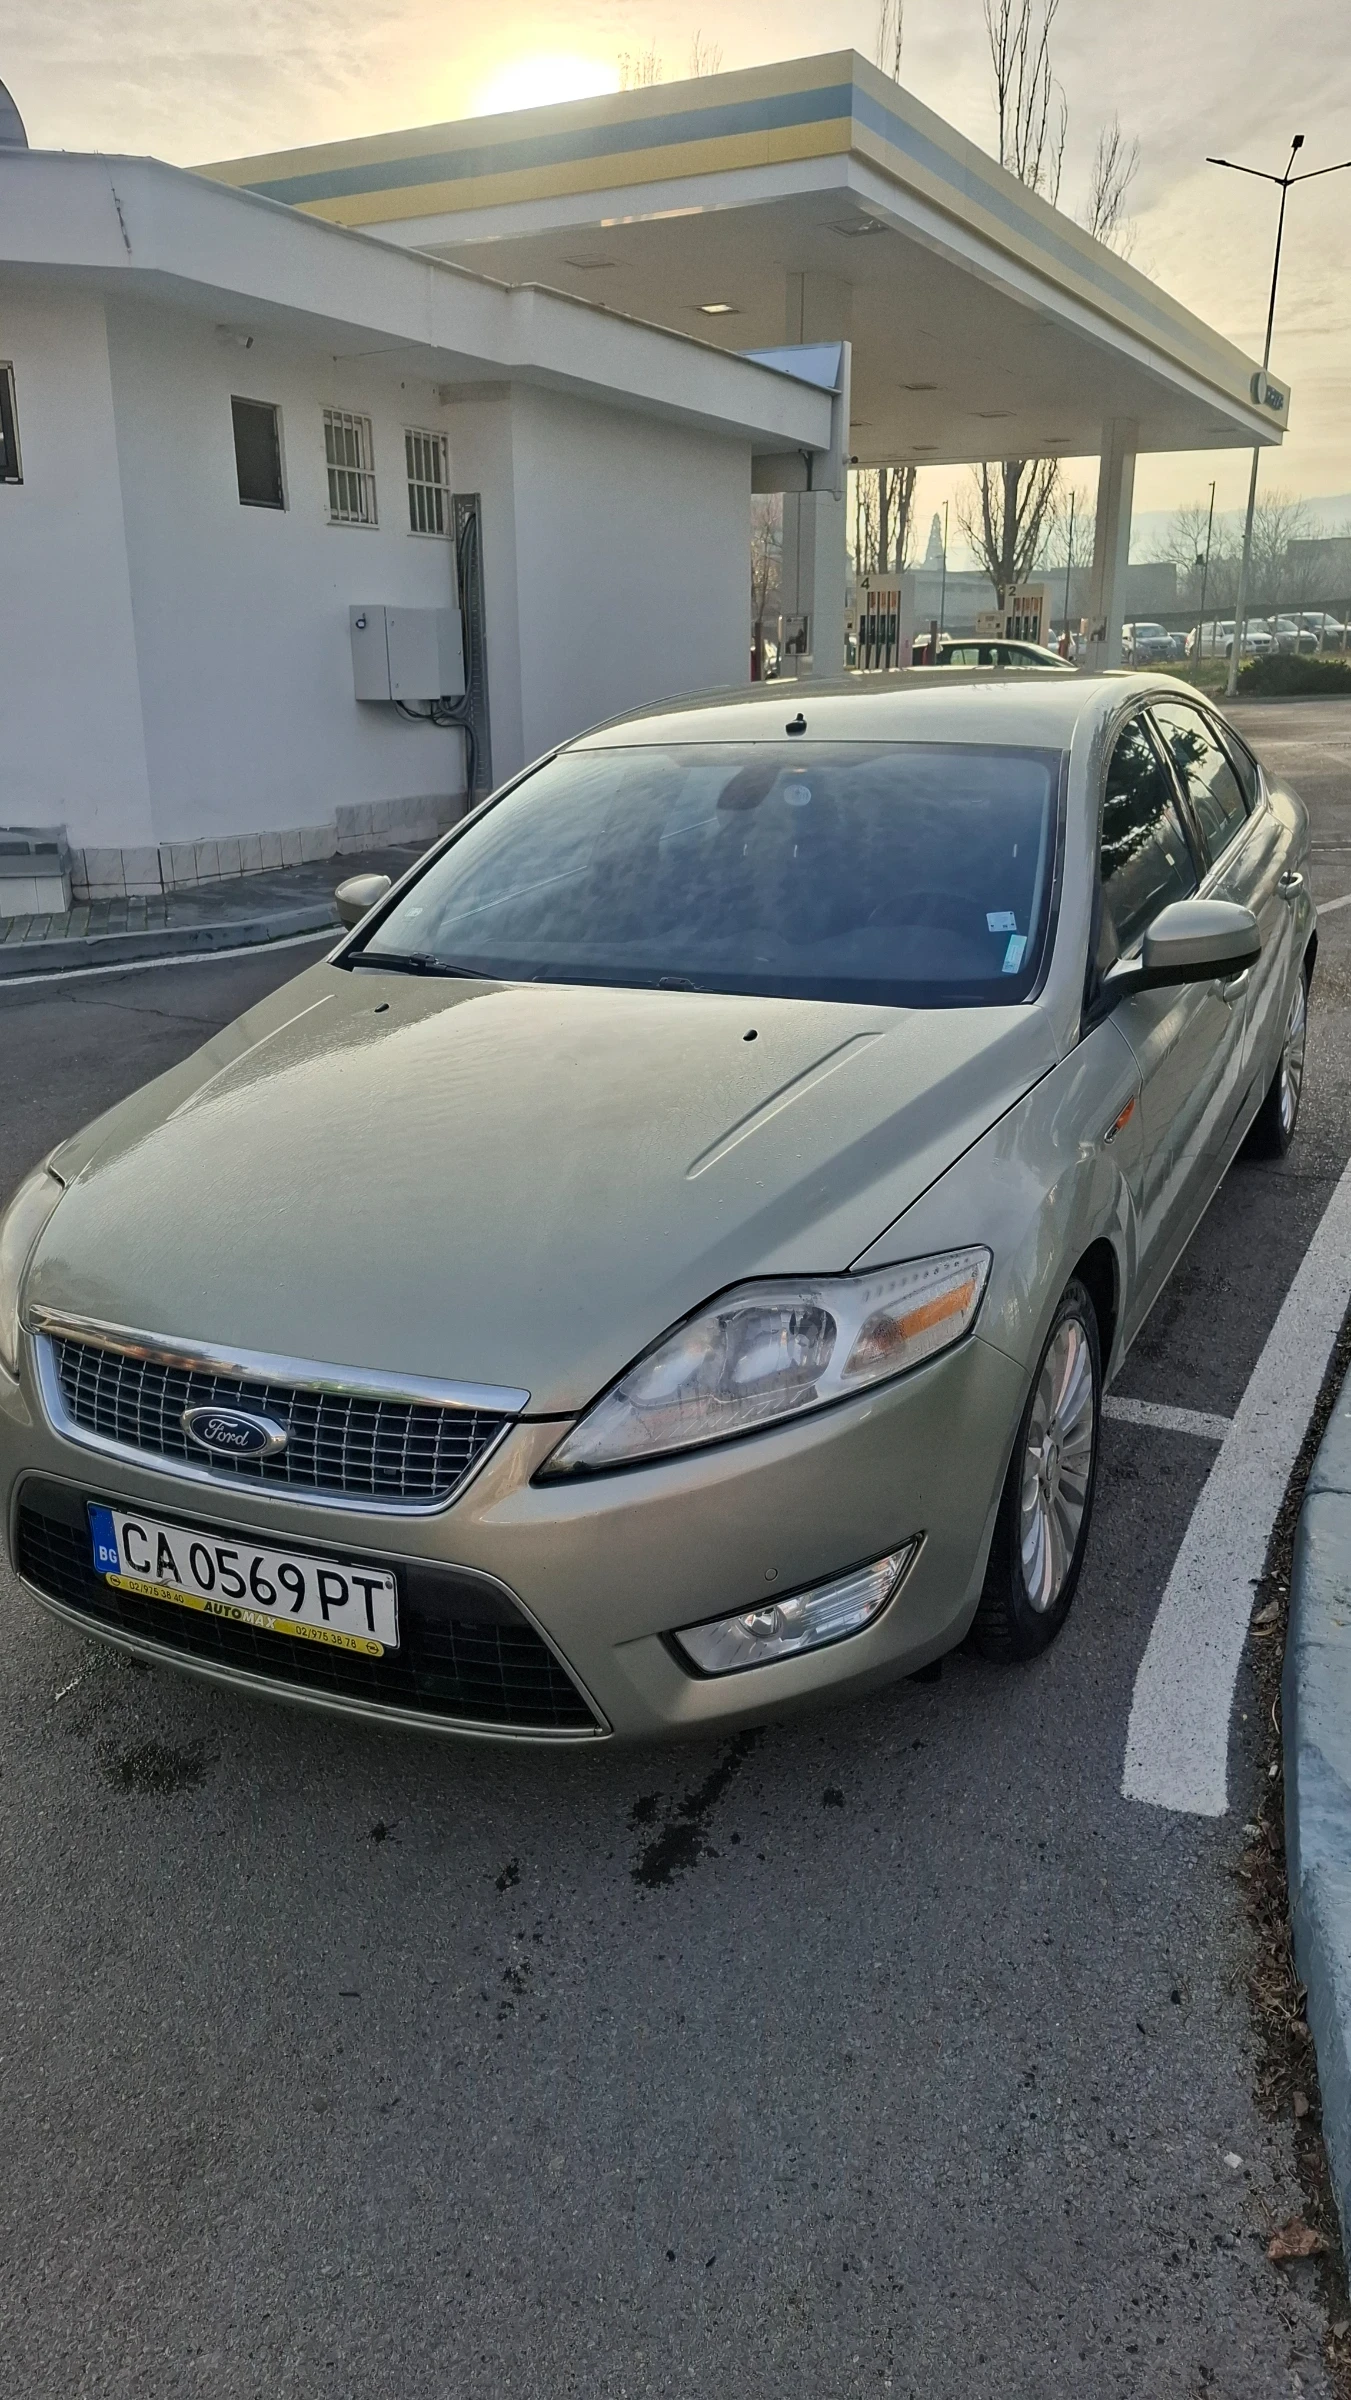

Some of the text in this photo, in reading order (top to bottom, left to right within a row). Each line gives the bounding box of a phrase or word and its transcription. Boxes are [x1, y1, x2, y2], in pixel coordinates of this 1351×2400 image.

[860, 577, 870, 590] 4
[1008, 586, 1017, 597] 2
[204, 1418, 250, 1447] Ford
[98, 1545, 118, 1564] BG
[121, 1521, 385, 1633] CA 0569 PT
[128, 1581, 185, 1604] 02/975 38 40
[203, 1601, 277, 1629] AUTOMAX
[295, 1625, 357, 1649] 02/975 38 78
